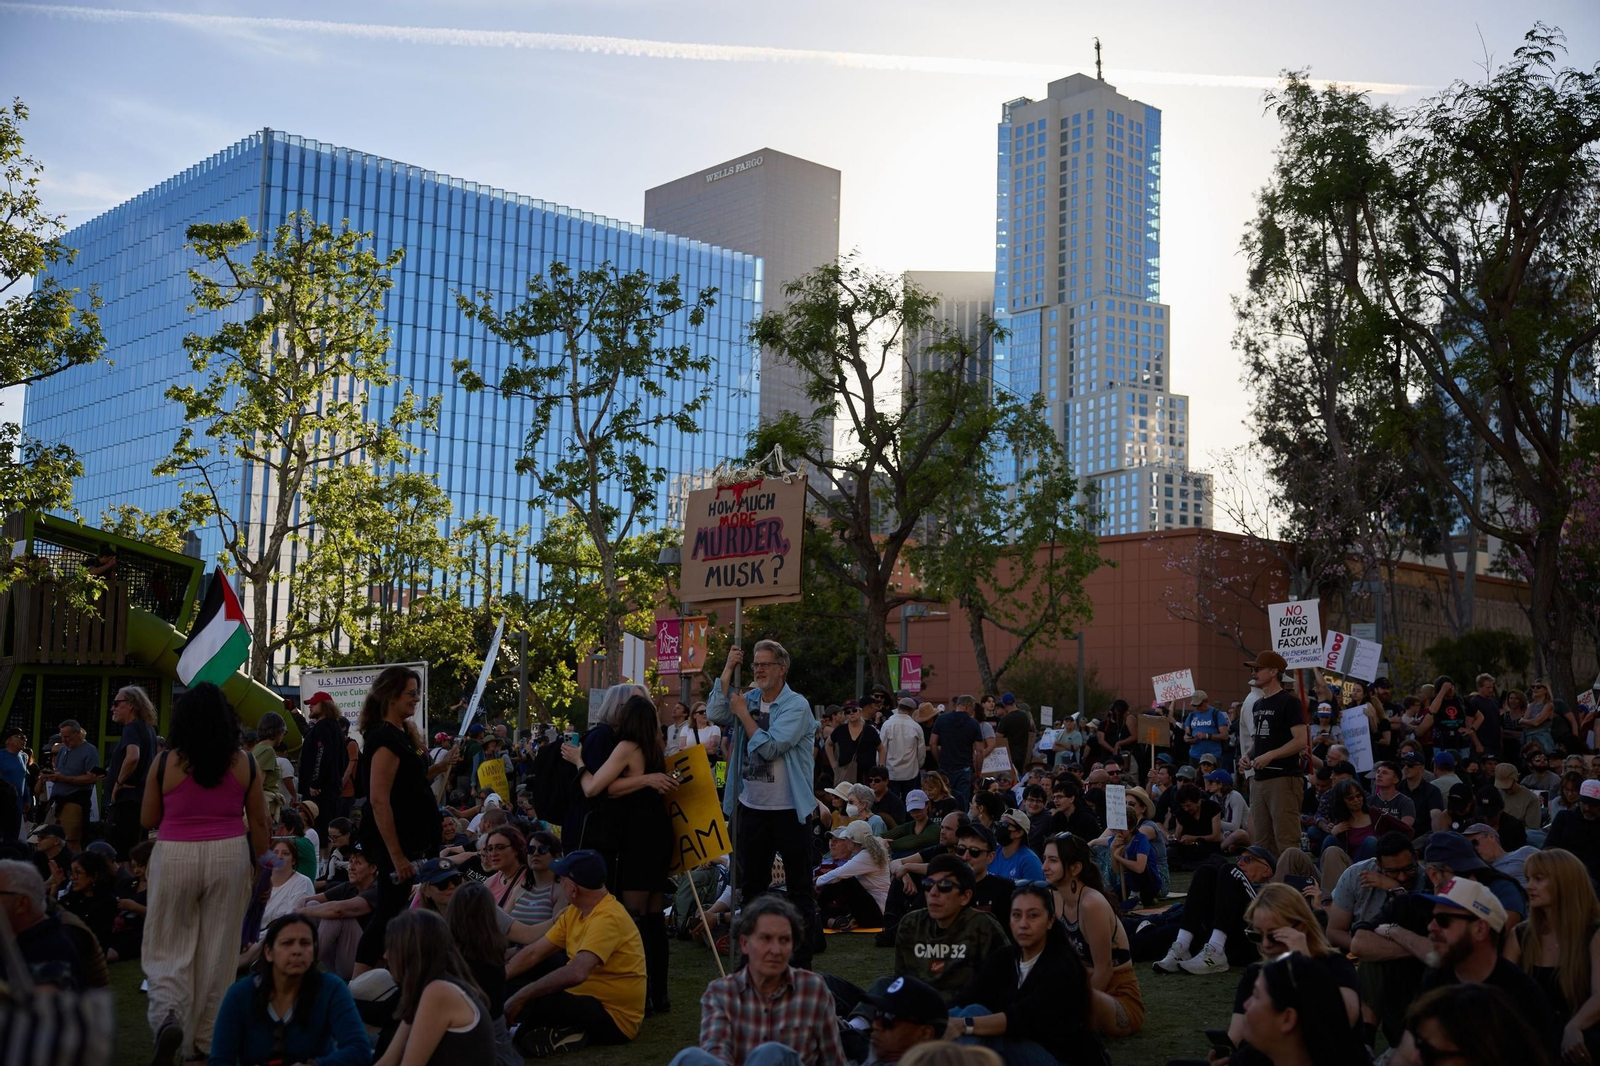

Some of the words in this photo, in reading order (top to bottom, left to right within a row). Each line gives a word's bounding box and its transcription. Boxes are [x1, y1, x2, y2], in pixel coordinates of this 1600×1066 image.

[706, 166, 734, 183] WELLS
[735, 156, 764, 173] FARGO
[708, 500, 735, 517] HOW
[737, 493, 776, 513] MUCH
[719, 512, 757, 530] MORE
[692, 519, 789, 559] MURDER,
[1286, 605, 1302, 616] NO
[1279, 615, 1308, 627] KINGS
[1281, 626, 1307, 637] ELON
[1278, 635, 1318, 649] FASCISM
[1326, 632, 1345, 670] DOGE
[318, 678, 334, 686] U.S.
[335, 676, 363, 685] HANDS
[1153, 674, 1174, 685] HANDS
[1176, 671, 1190, 679] OFF
[350, 688, 368, 696] Cuba
